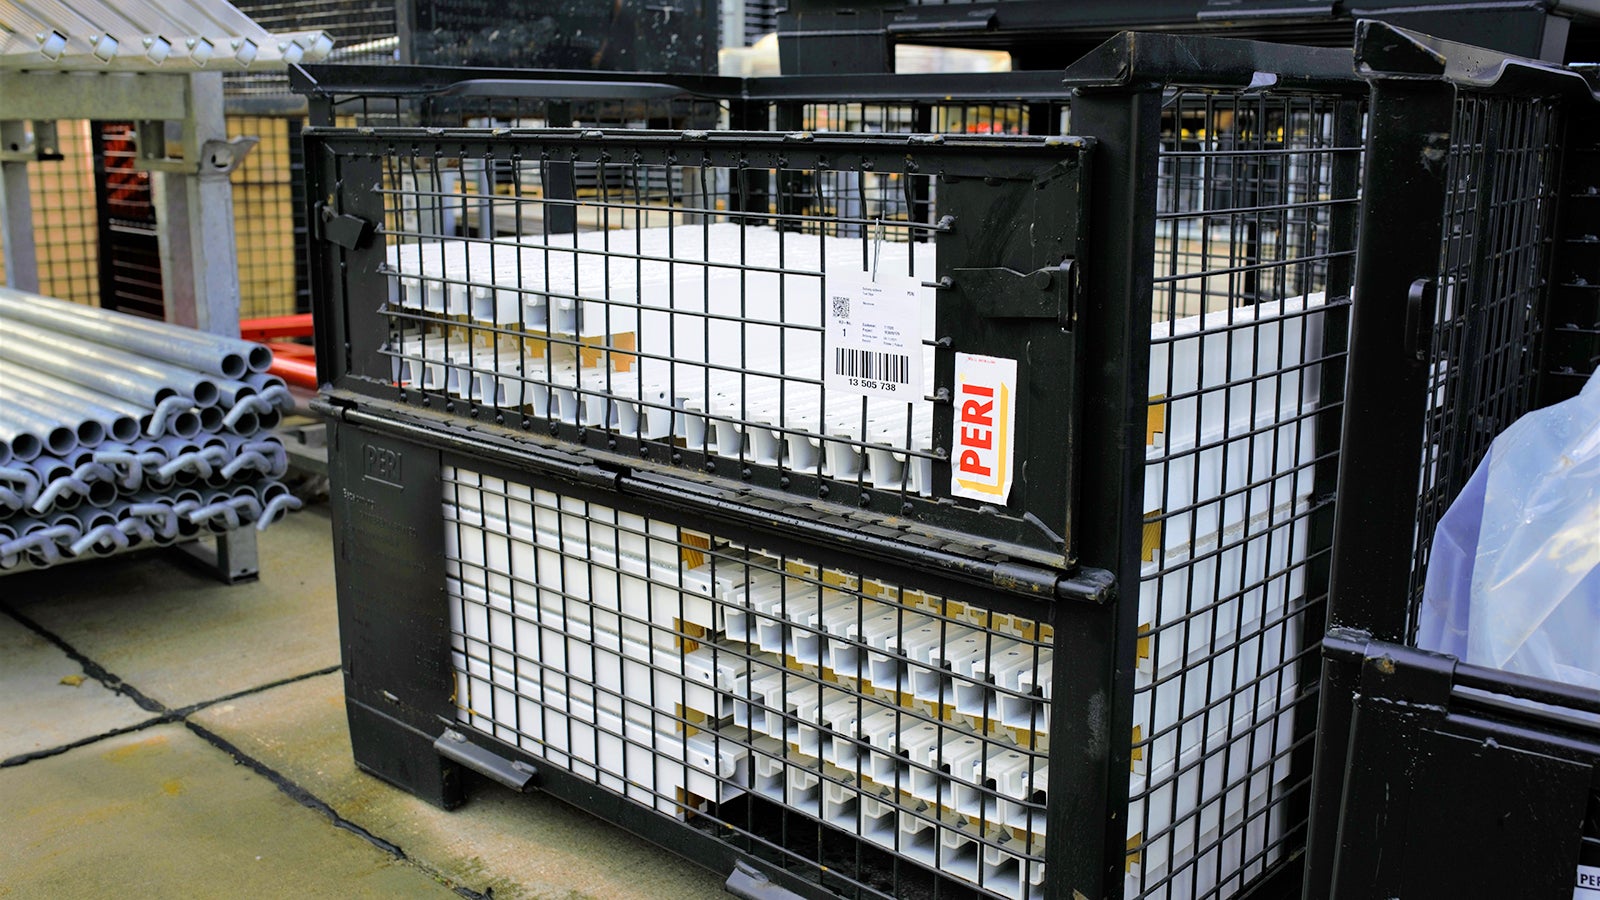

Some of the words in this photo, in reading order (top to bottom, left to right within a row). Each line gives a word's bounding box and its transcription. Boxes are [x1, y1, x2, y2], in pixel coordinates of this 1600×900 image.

[848, 378, 859, 386] 13
[861, 380, 877, 389] 505
[880, 382, 896, 392] 738
[960, 384, 994, 477] PERI
[366, 443, 403, 482] PERI
